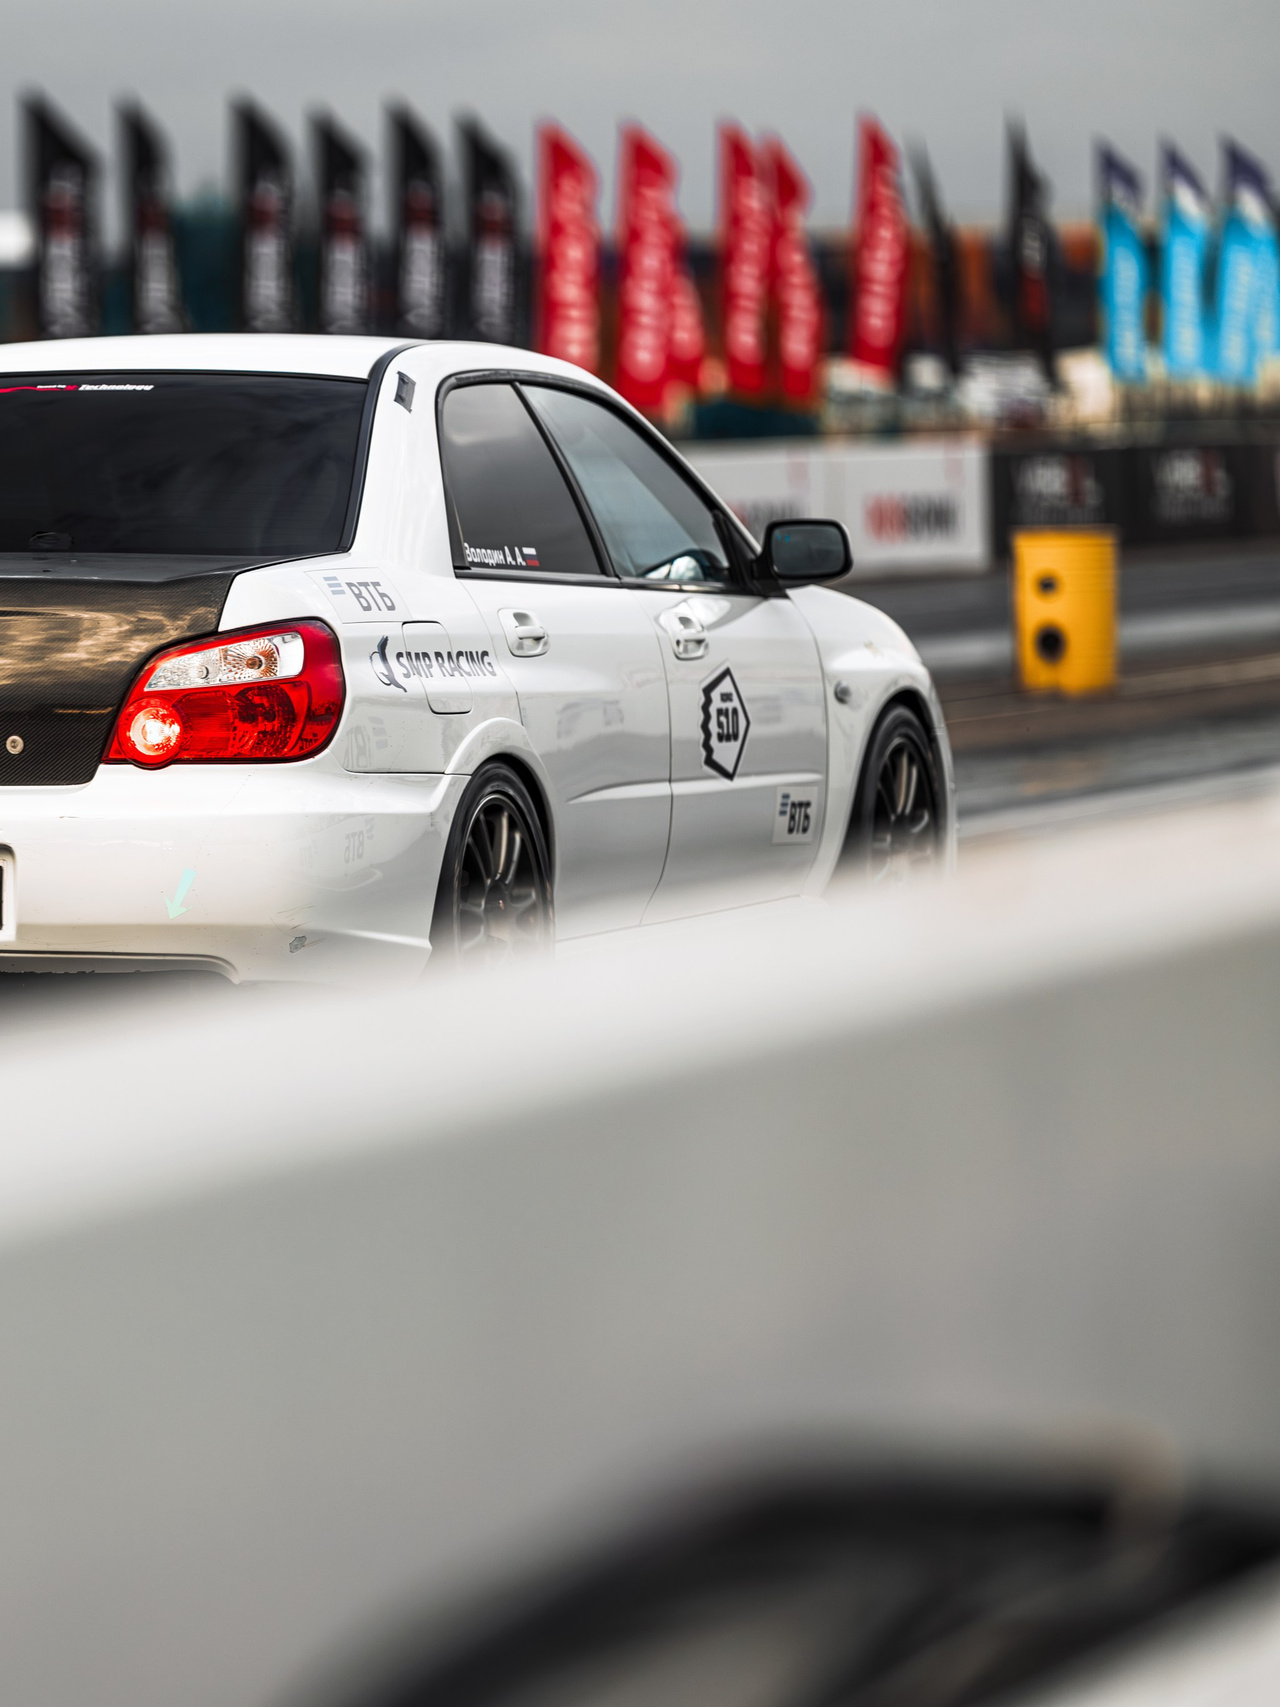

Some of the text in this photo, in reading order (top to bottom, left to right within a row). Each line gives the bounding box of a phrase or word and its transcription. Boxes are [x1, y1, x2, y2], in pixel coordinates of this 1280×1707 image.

[345, 581, 396, 611] ВТБ
[396, 650, 497, 678] SMP RACING
[716, 707, 739, 743] 510
[787, 801, 811, 834] ВТБ
